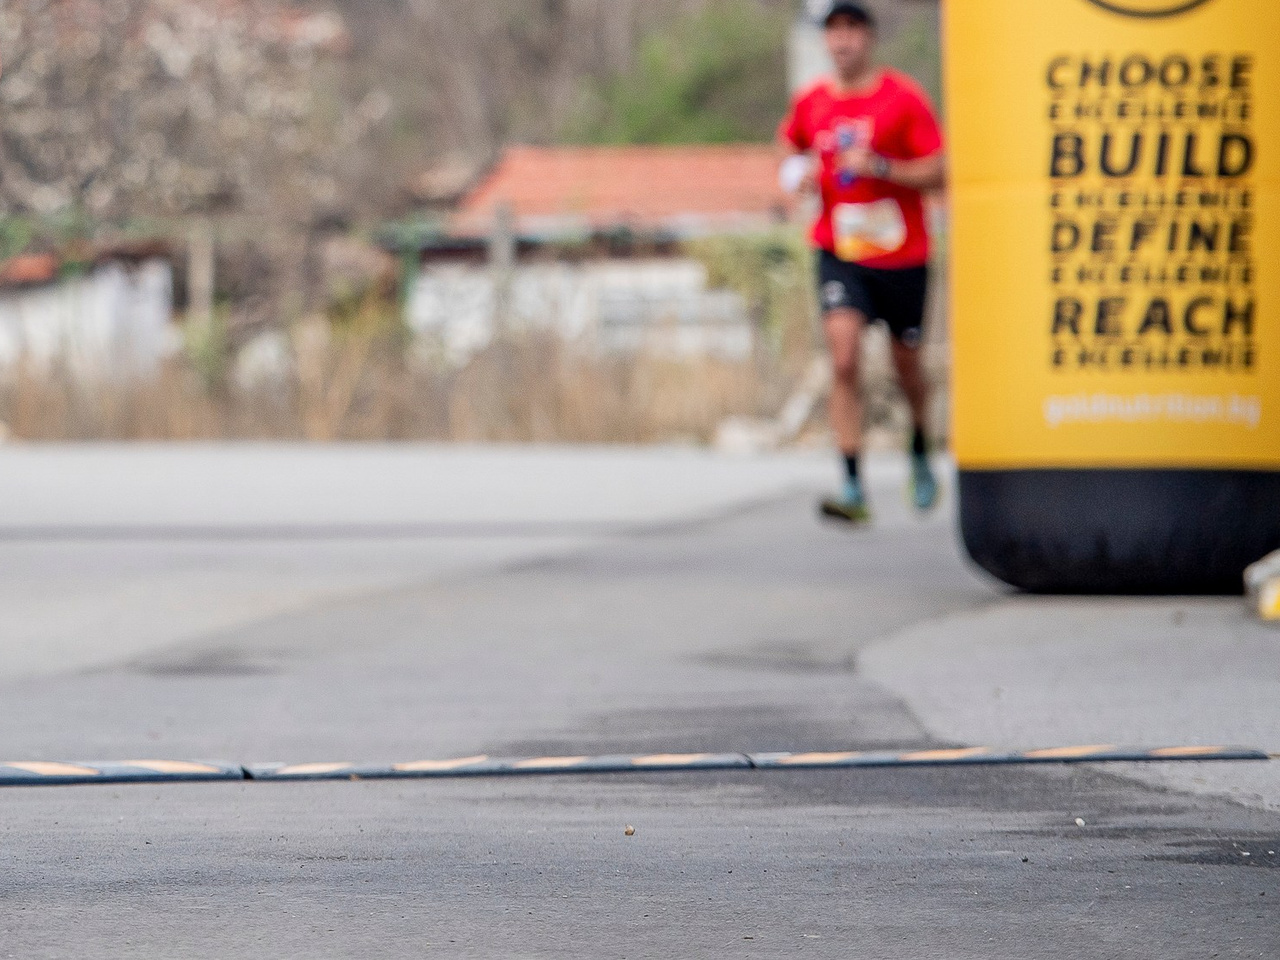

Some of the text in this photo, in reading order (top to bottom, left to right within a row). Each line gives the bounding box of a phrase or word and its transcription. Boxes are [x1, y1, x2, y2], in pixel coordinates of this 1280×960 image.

[1046, 53, 1254, 90] CHOOSE
[1048, 132, 1256, 178] BUILD
[1050, 219, 1253, 253] DEFINE
[1051, 296, 1256, 337] REACH
